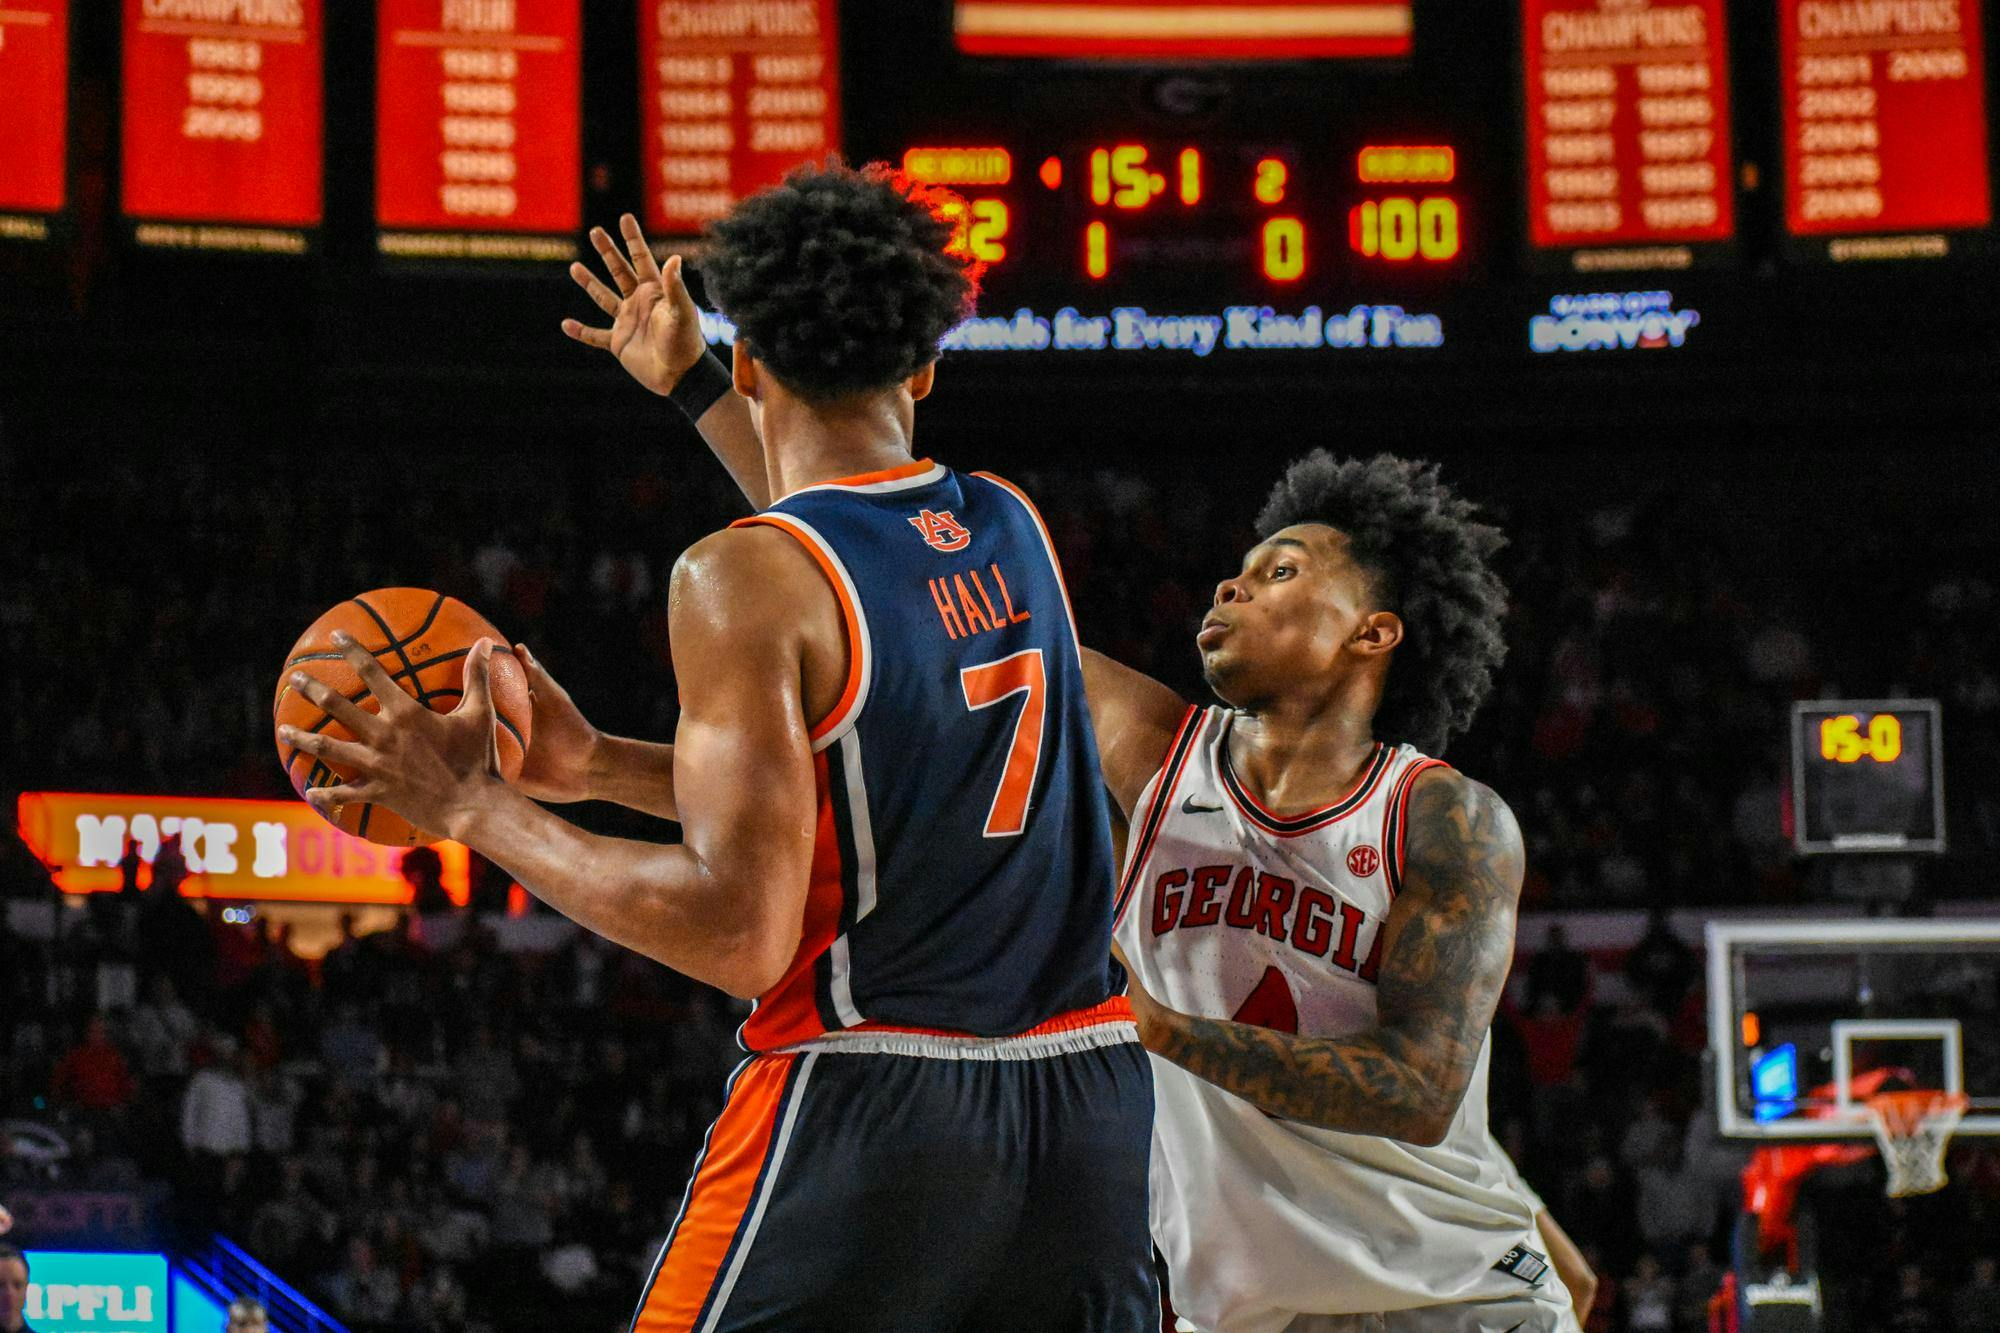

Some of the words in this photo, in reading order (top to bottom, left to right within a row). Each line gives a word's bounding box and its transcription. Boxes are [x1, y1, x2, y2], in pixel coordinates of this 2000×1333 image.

[1255, 158, 1287, 204] 2
[1086, 220, 1108, 280] 1
[1263, 216, 1305, 282] 0
[1360, 197, 1459, 261] 100
[1054, 306, 1109, 350] for
[1111, 306, 1222, 356] Every
[1223, 305, 1323, 349] Kind
[1324, 304, 1370, 348] of
[929, 563, 1031, 640] HALL
[960, 648, 1046, 838] 7
